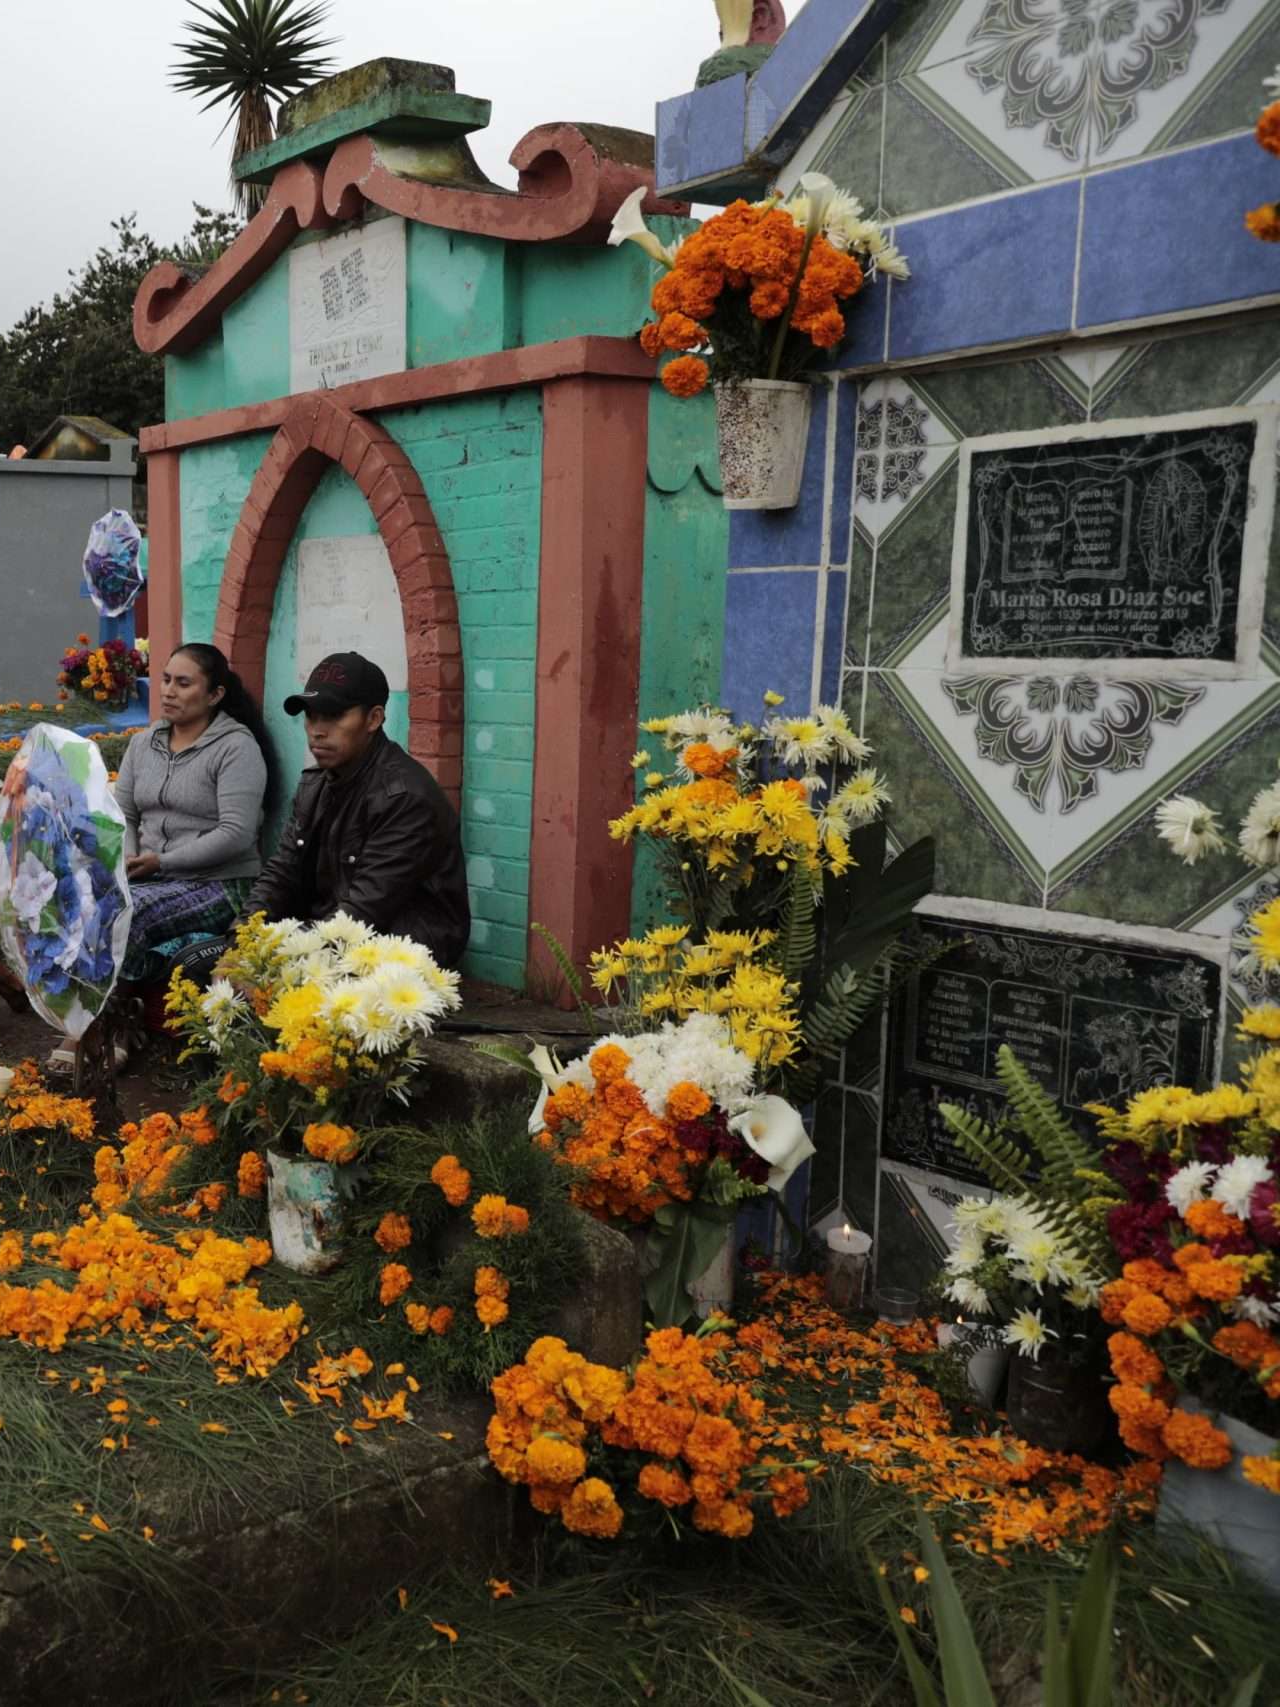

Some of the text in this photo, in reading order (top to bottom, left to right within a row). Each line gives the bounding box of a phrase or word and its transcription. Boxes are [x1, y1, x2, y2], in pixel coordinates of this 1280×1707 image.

[1103, 487, 1113, 497] tu
[1052, 588, 1102, 607] Rosa
[1162, 585, 1206, 606] Soc
[1122, 607, 1158, 620] Marzo
[1160, 607, 1189, 620] 2019
[1097, 623, 1120, 633] hijos
